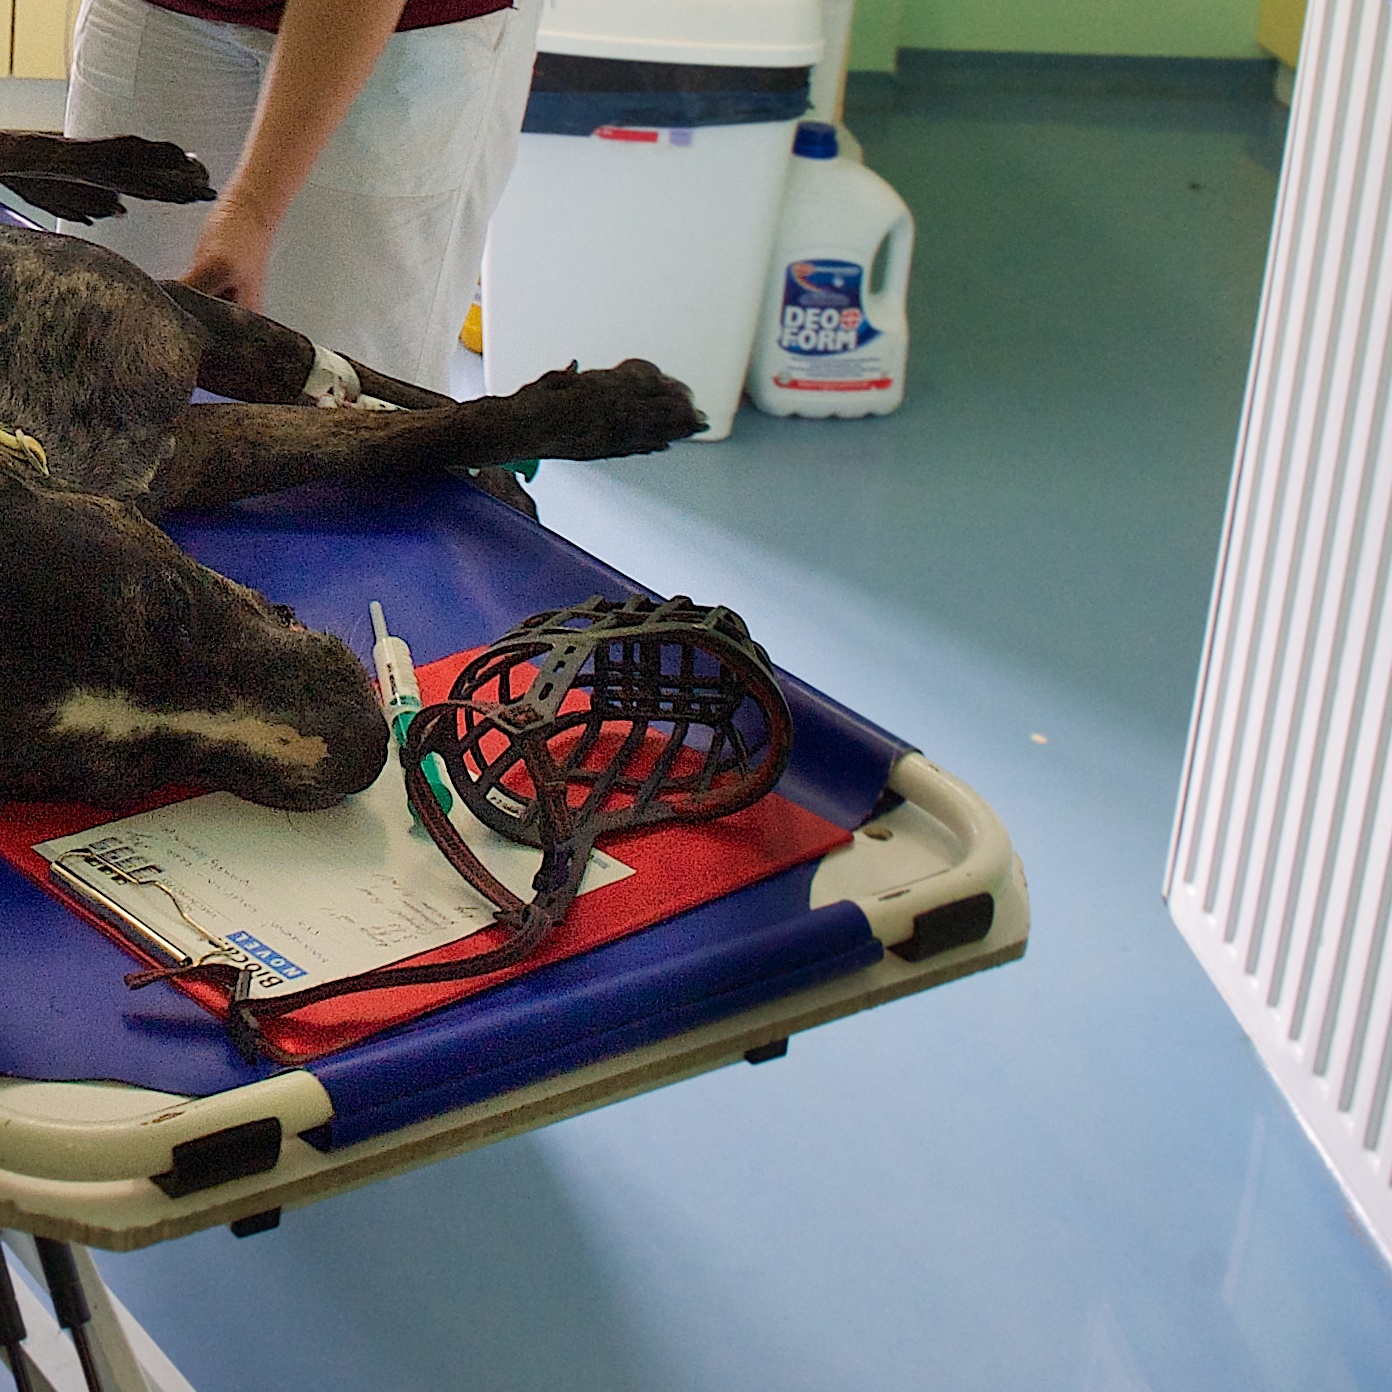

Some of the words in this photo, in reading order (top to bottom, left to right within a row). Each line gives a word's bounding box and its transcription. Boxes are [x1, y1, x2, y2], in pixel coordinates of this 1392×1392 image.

[784, 306, 840, 330] DEO
[782, 327, 857, 351] FORM
[234, 932, 302, 977] NOVEL
